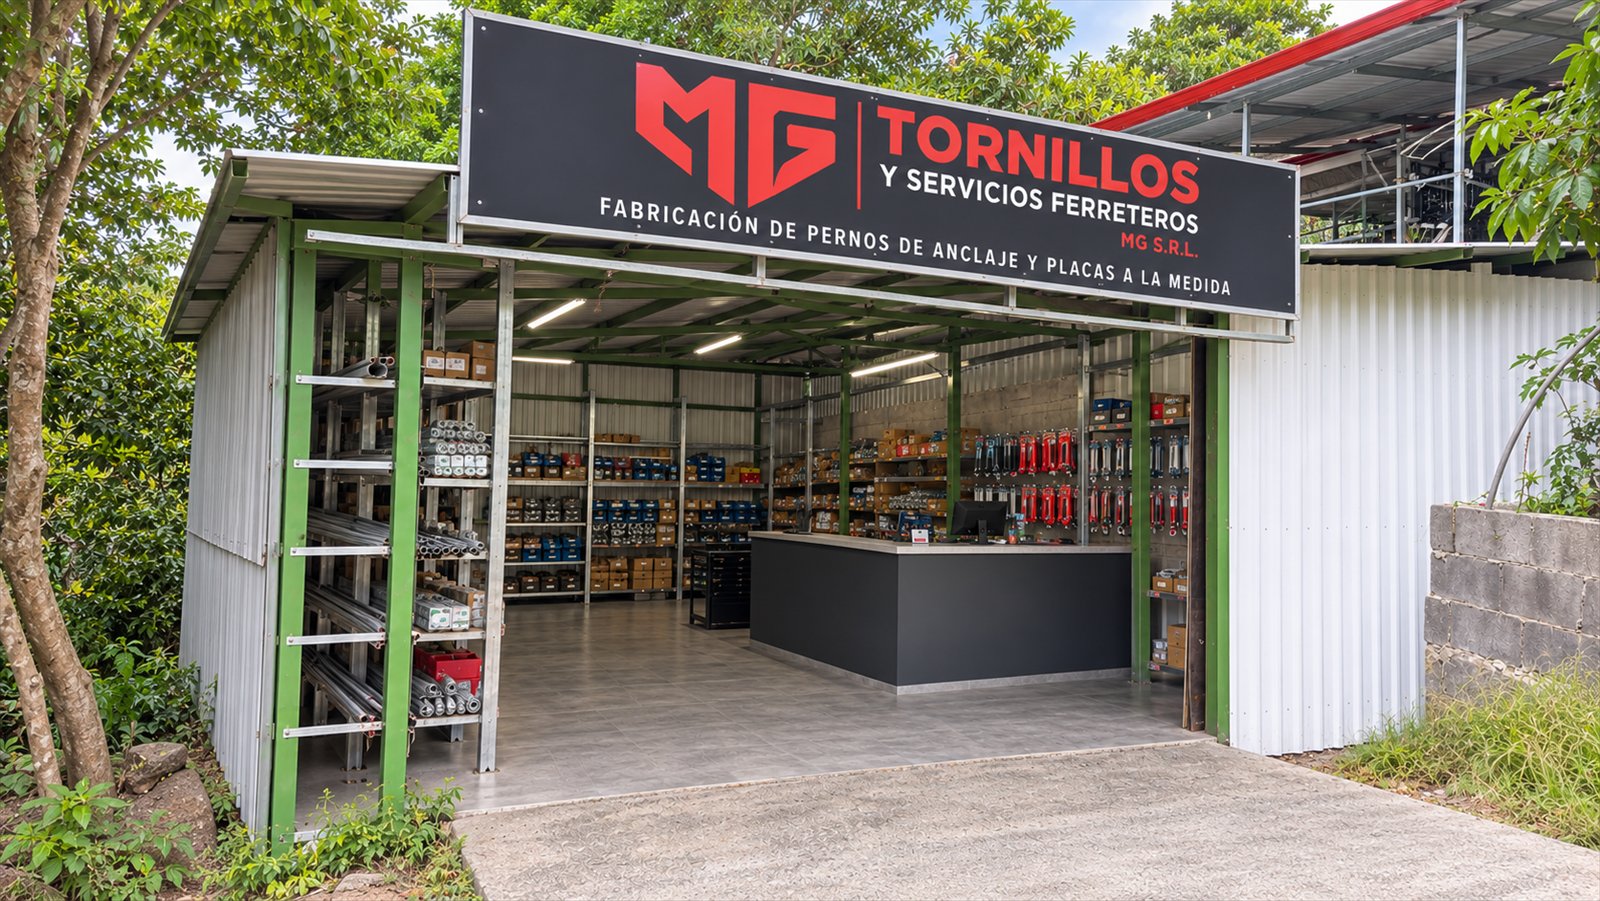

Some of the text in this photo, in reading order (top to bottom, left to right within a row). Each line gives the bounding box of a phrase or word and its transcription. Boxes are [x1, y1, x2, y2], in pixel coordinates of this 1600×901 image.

[636, 62, 837, 208] MG
[877, 105, 1200, 205] TORNILLOS
[600, 196, 1231, 296] FABRICACIÓN DE PERNOS DE ANCLAJE Y PLACAS A LA MEDIDA
[880, 164, 1199, 235] Y SERVICIOS FERRETEROS
[1121, 232, 1199, 259] MG S.R.L.
